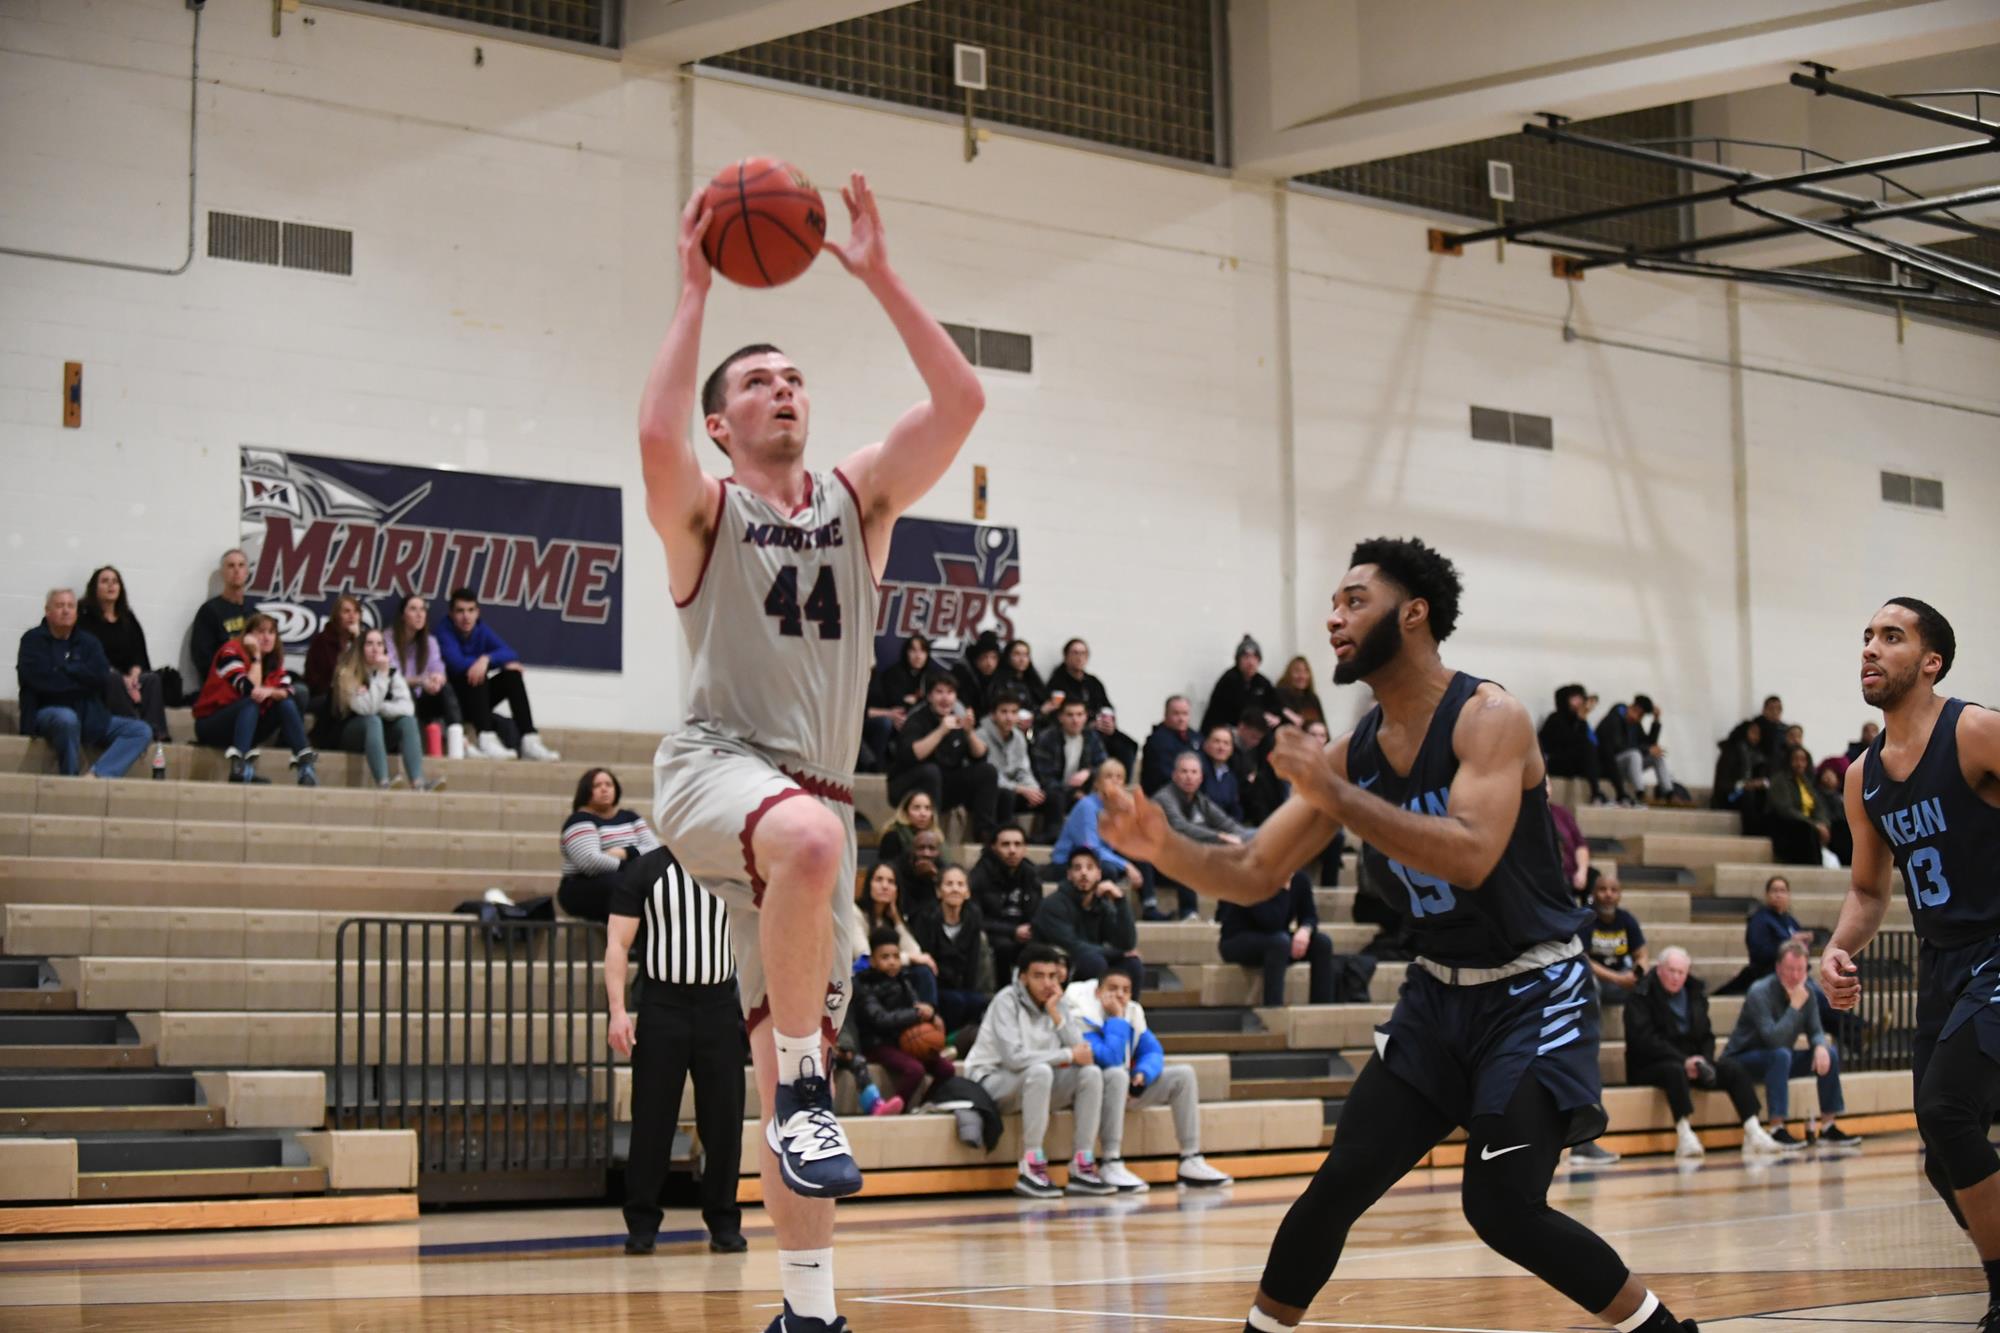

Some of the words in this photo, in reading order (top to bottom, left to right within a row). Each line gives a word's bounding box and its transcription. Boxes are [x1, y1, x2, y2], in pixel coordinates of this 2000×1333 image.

[247, 515, 621, 624] MARITIME
[764, 564, 842, 640] 44
[876, 583, 1019, 642] TEERS
[1881, 797, 1947, 846] KEAN
[1907, 846, 1951, 909] 13
